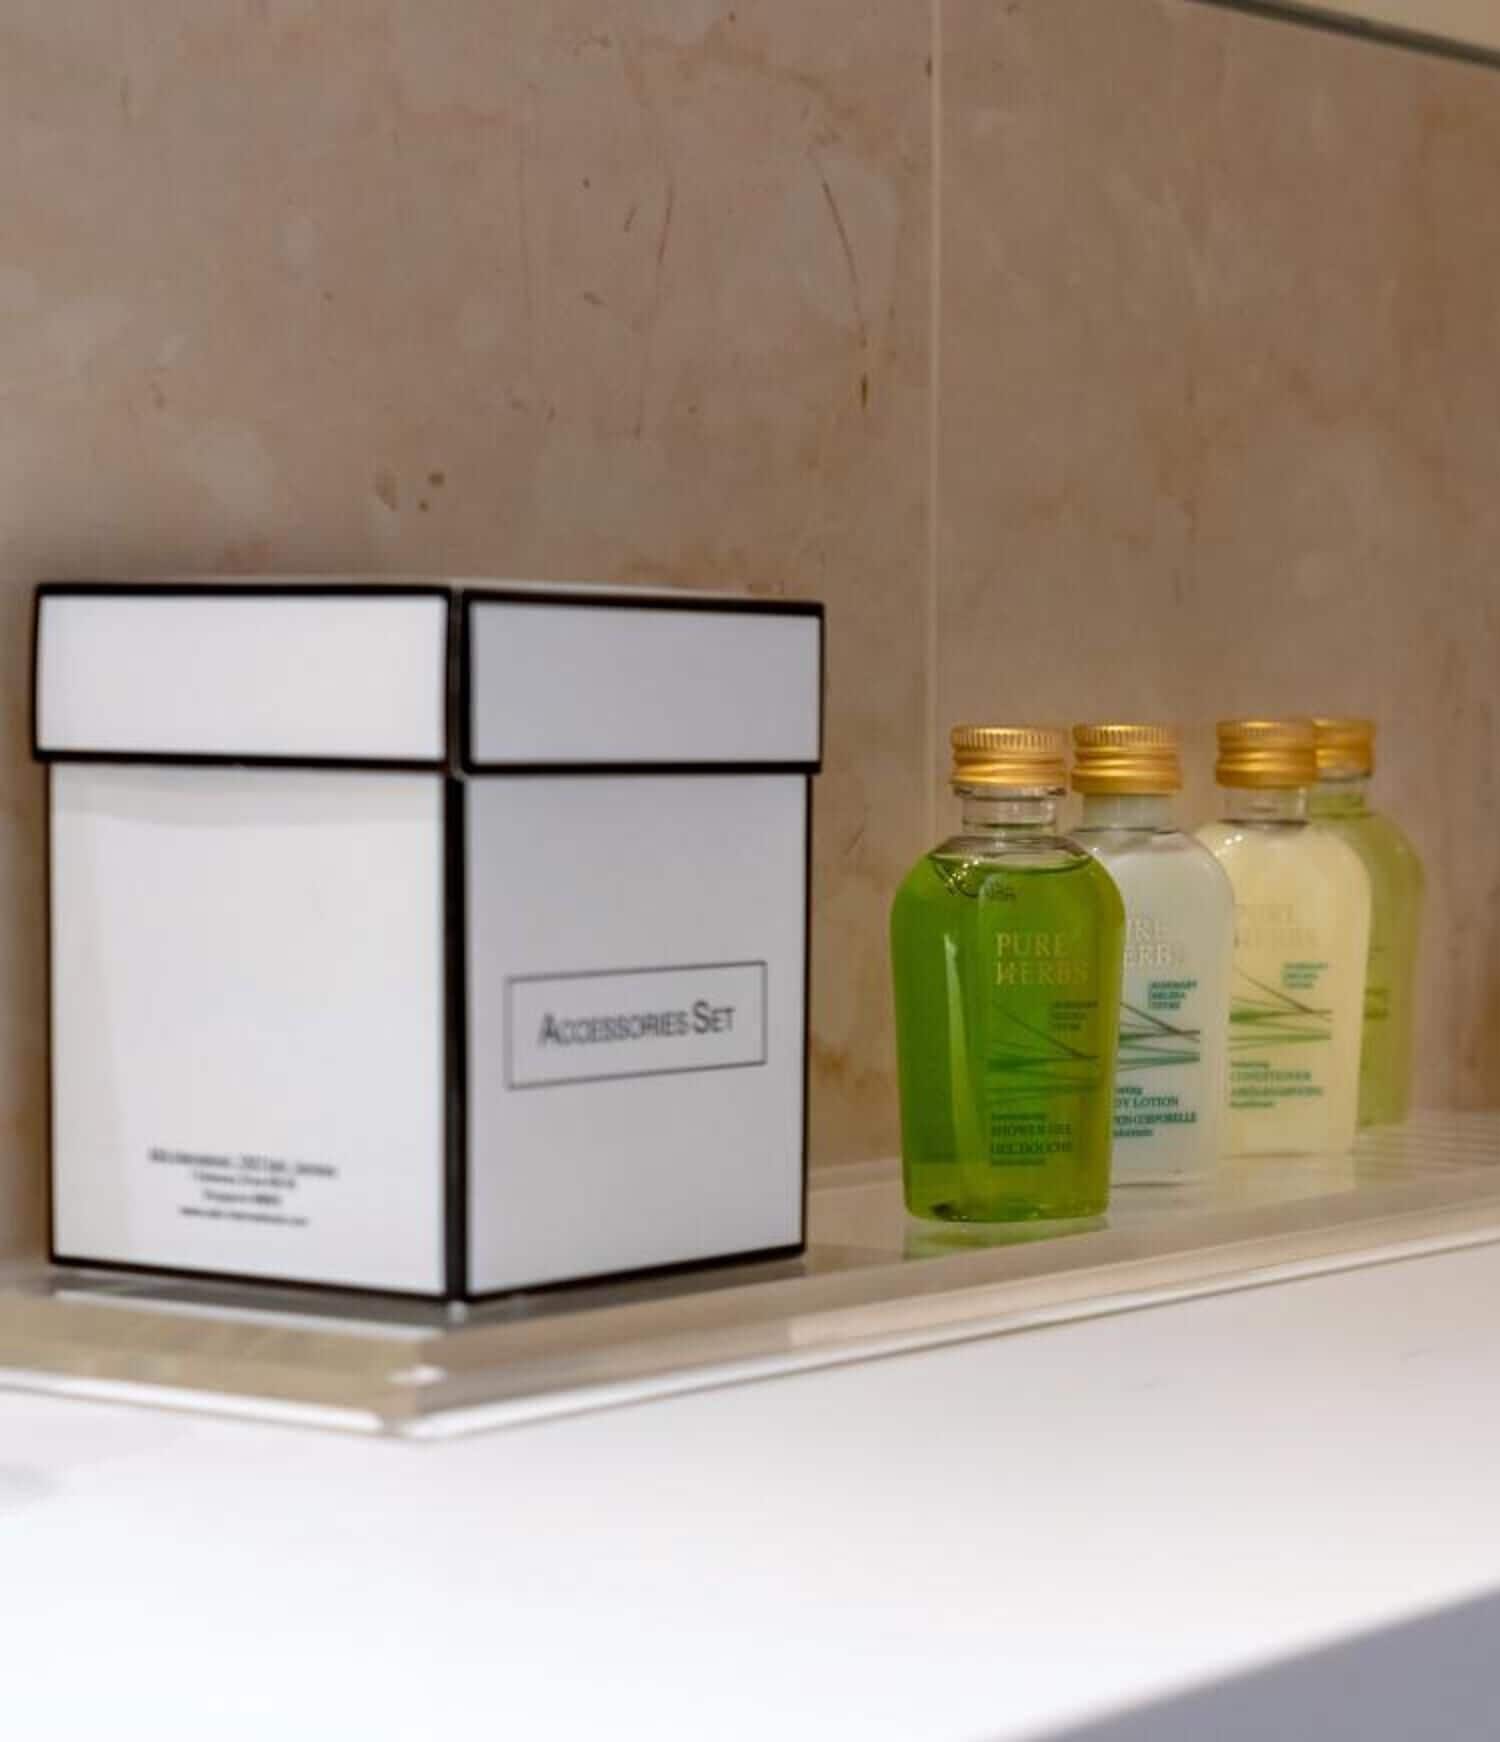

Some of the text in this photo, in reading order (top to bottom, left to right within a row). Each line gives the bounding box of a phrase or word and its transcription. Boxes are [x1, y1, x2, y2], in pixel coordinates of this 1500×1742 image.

[995, 931, 1070, 958] PURE
[993, 959, 1089, 985] HERBS
[1133, 1096, 1179, 1107] LOTION
